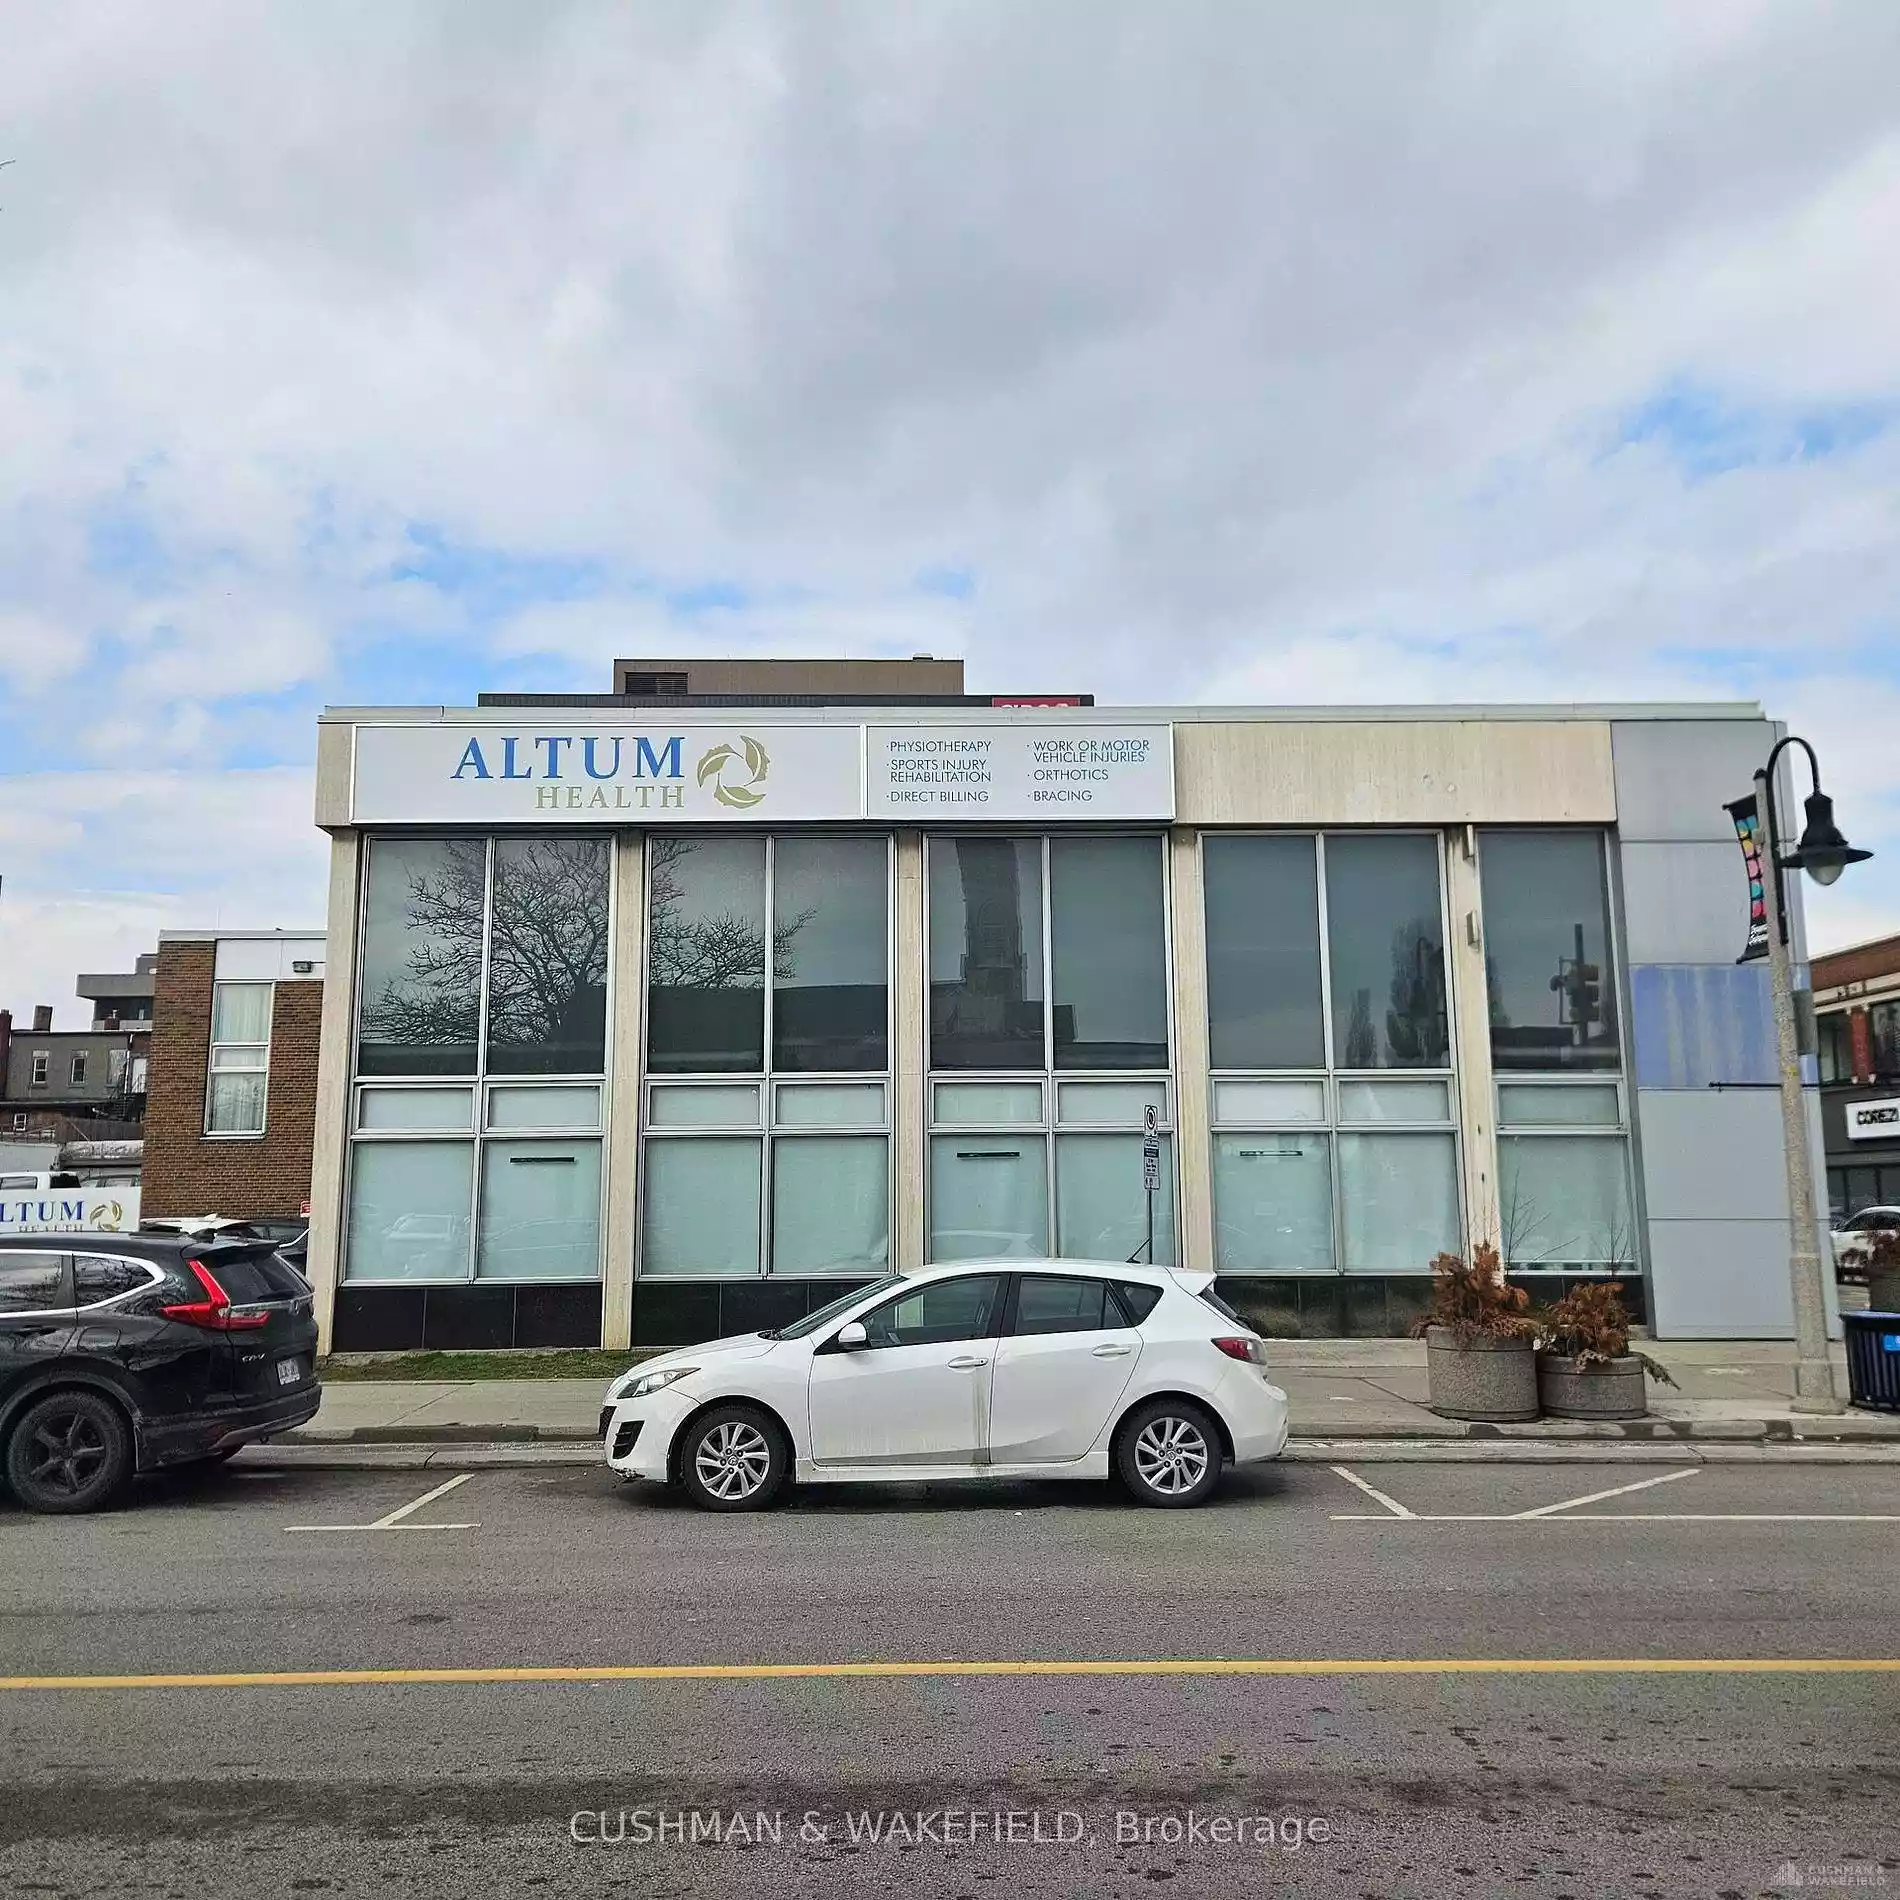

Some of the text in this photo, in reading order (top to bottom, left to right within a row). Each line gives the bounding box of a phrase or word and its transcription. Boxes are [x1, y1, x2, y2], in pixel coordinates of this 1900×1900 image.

[890, 740, 991, 752] PHYSIOTHERAPY
[1033, 740, 1150, 751] WORK OR MOTOR
[450, 737, 685, 779] ALTUM
[1033, 751, 1145, 762] VEHICLE INJURIES
[891, 759, 986, 770] SPORTS INJURY
[890, 771, 991, 782] REHABILITATION
[1033, 769, 1109, 780] ORTHOTICS
[535, 786, 684, 808] HEALTH
[890, 791, 989, 802] DIRECT BILLING
[1033, 790, 1093, 801] BRACING
[0, 1200, 84, 1222] LTUM
